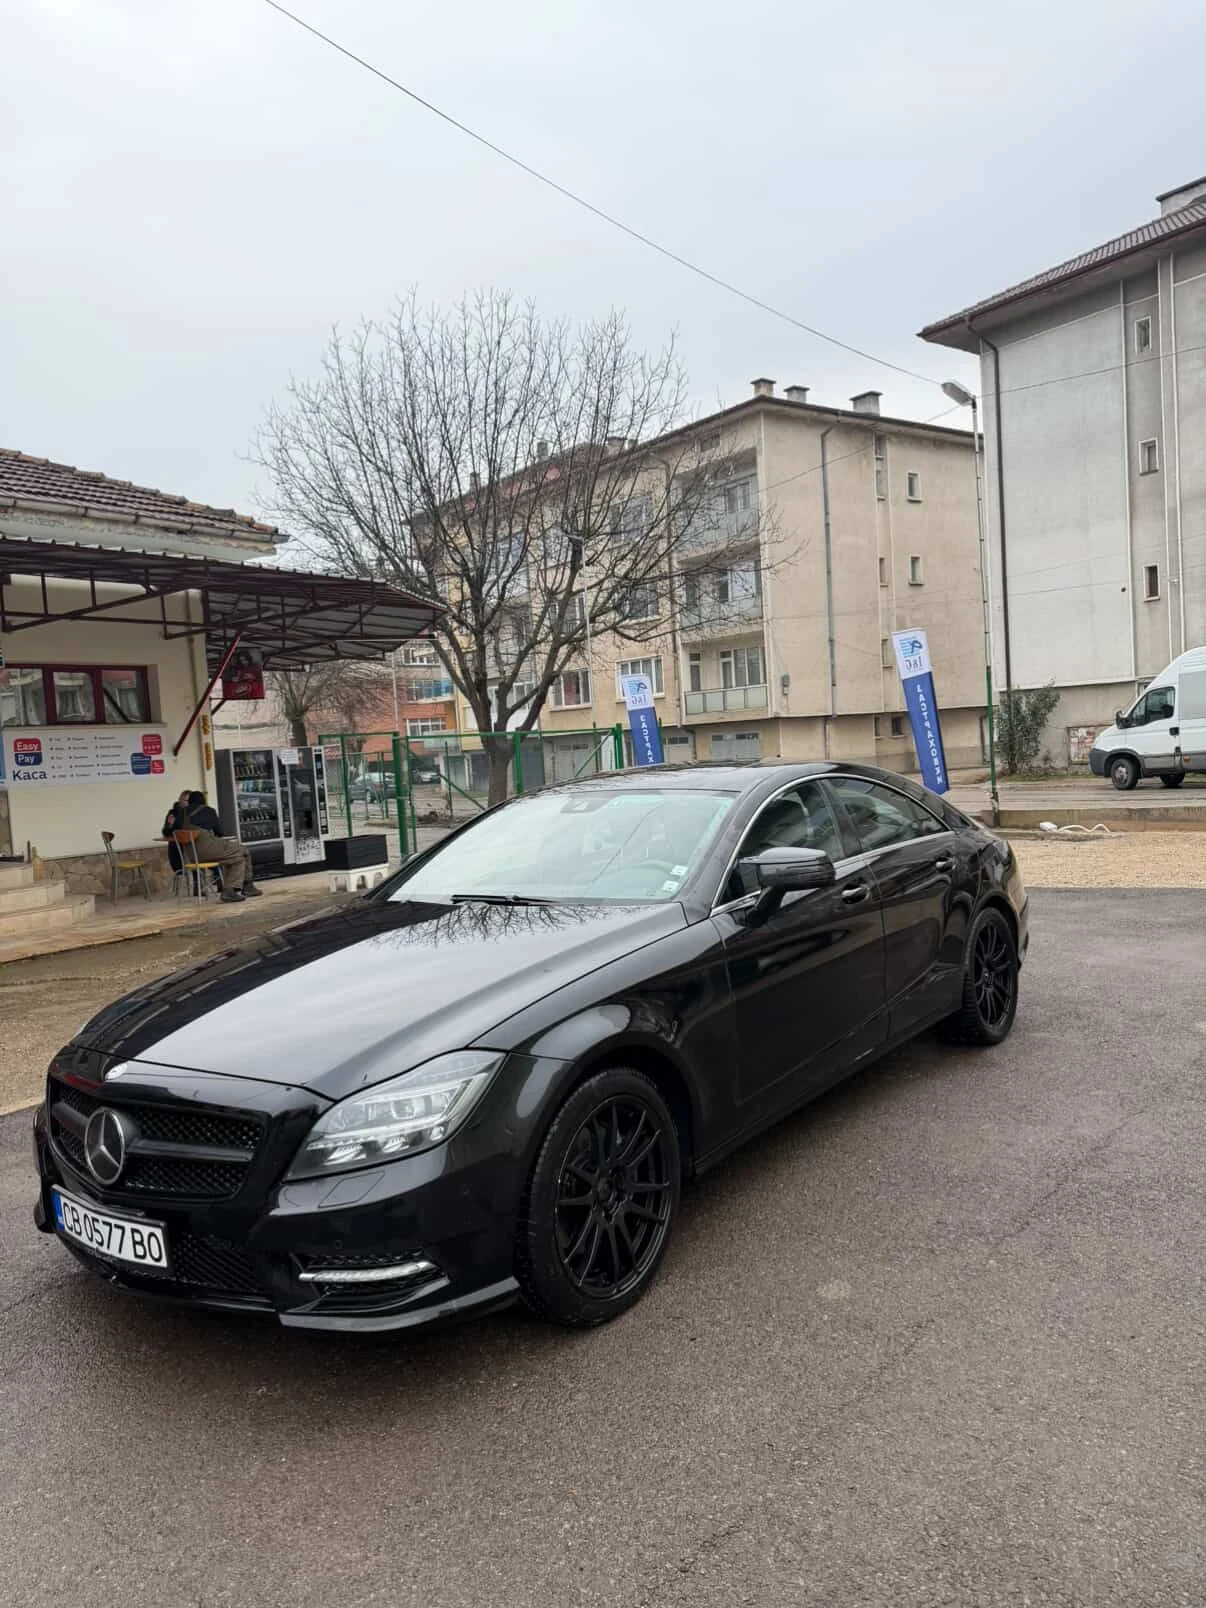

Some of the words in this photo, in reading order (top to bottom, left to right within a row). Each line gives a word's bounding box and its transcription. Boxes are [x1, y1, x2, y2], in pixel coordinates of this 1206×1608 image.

[16, 742, 39, 752] Easy
[17, 754, 35, 764] Pay
[13, 770, 47, 781] Каса
